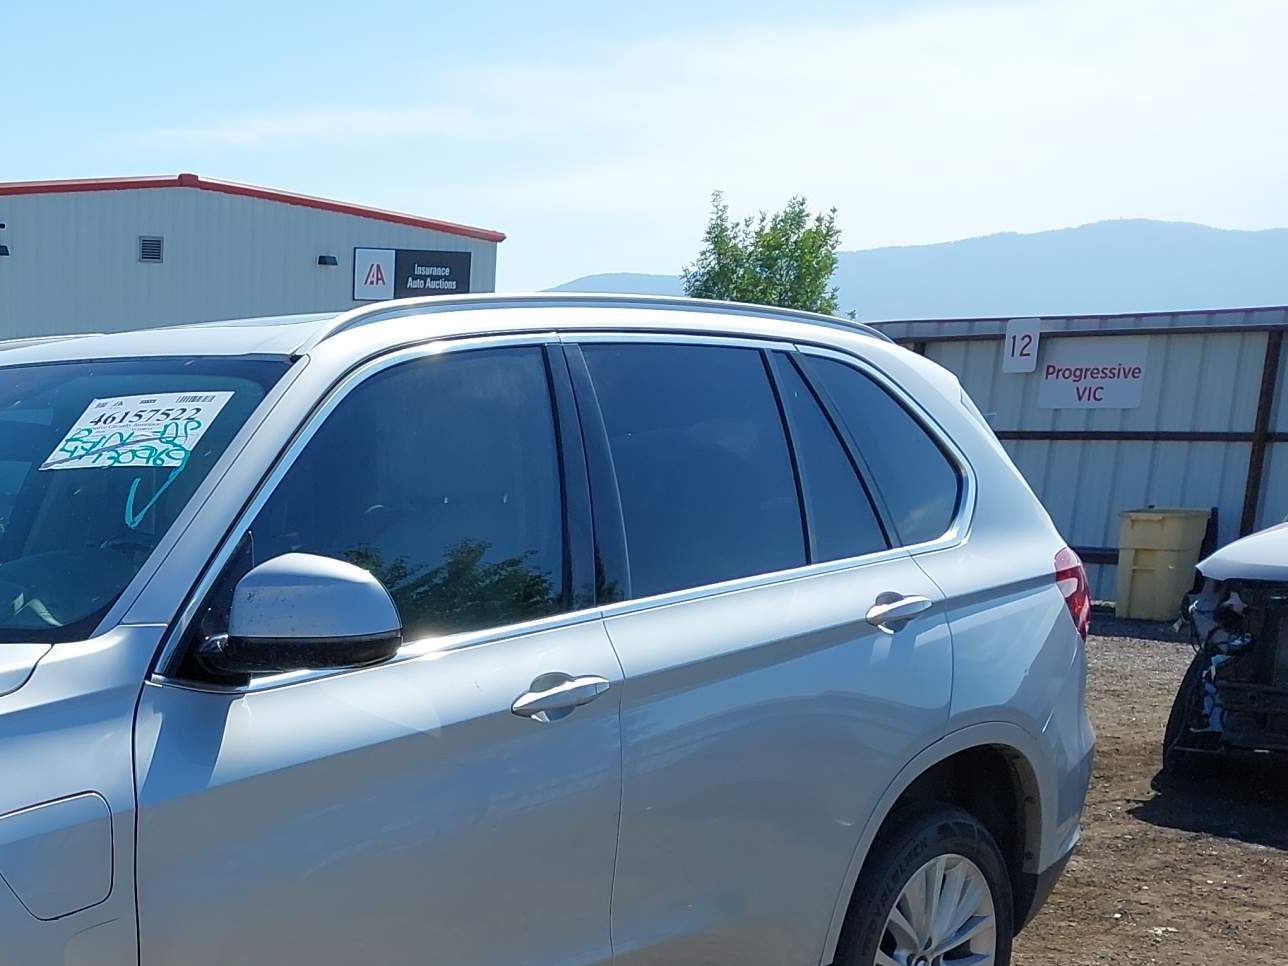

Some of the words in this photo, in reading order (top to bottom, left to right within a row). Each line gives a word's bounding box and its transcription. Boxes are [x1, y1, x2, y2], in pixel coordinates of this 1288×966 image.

[414, 263, 450, 275] Insurance
[407, 276, 424, 289] Auto
[425, 277, 457, 290] Auctions
[1011, 333, 1033, 358] 12
[1045, 363, 1142, 382] Progressive
[1076, 386, 1105, 402] VIC
[89, 407, 203, 426] 46157522
